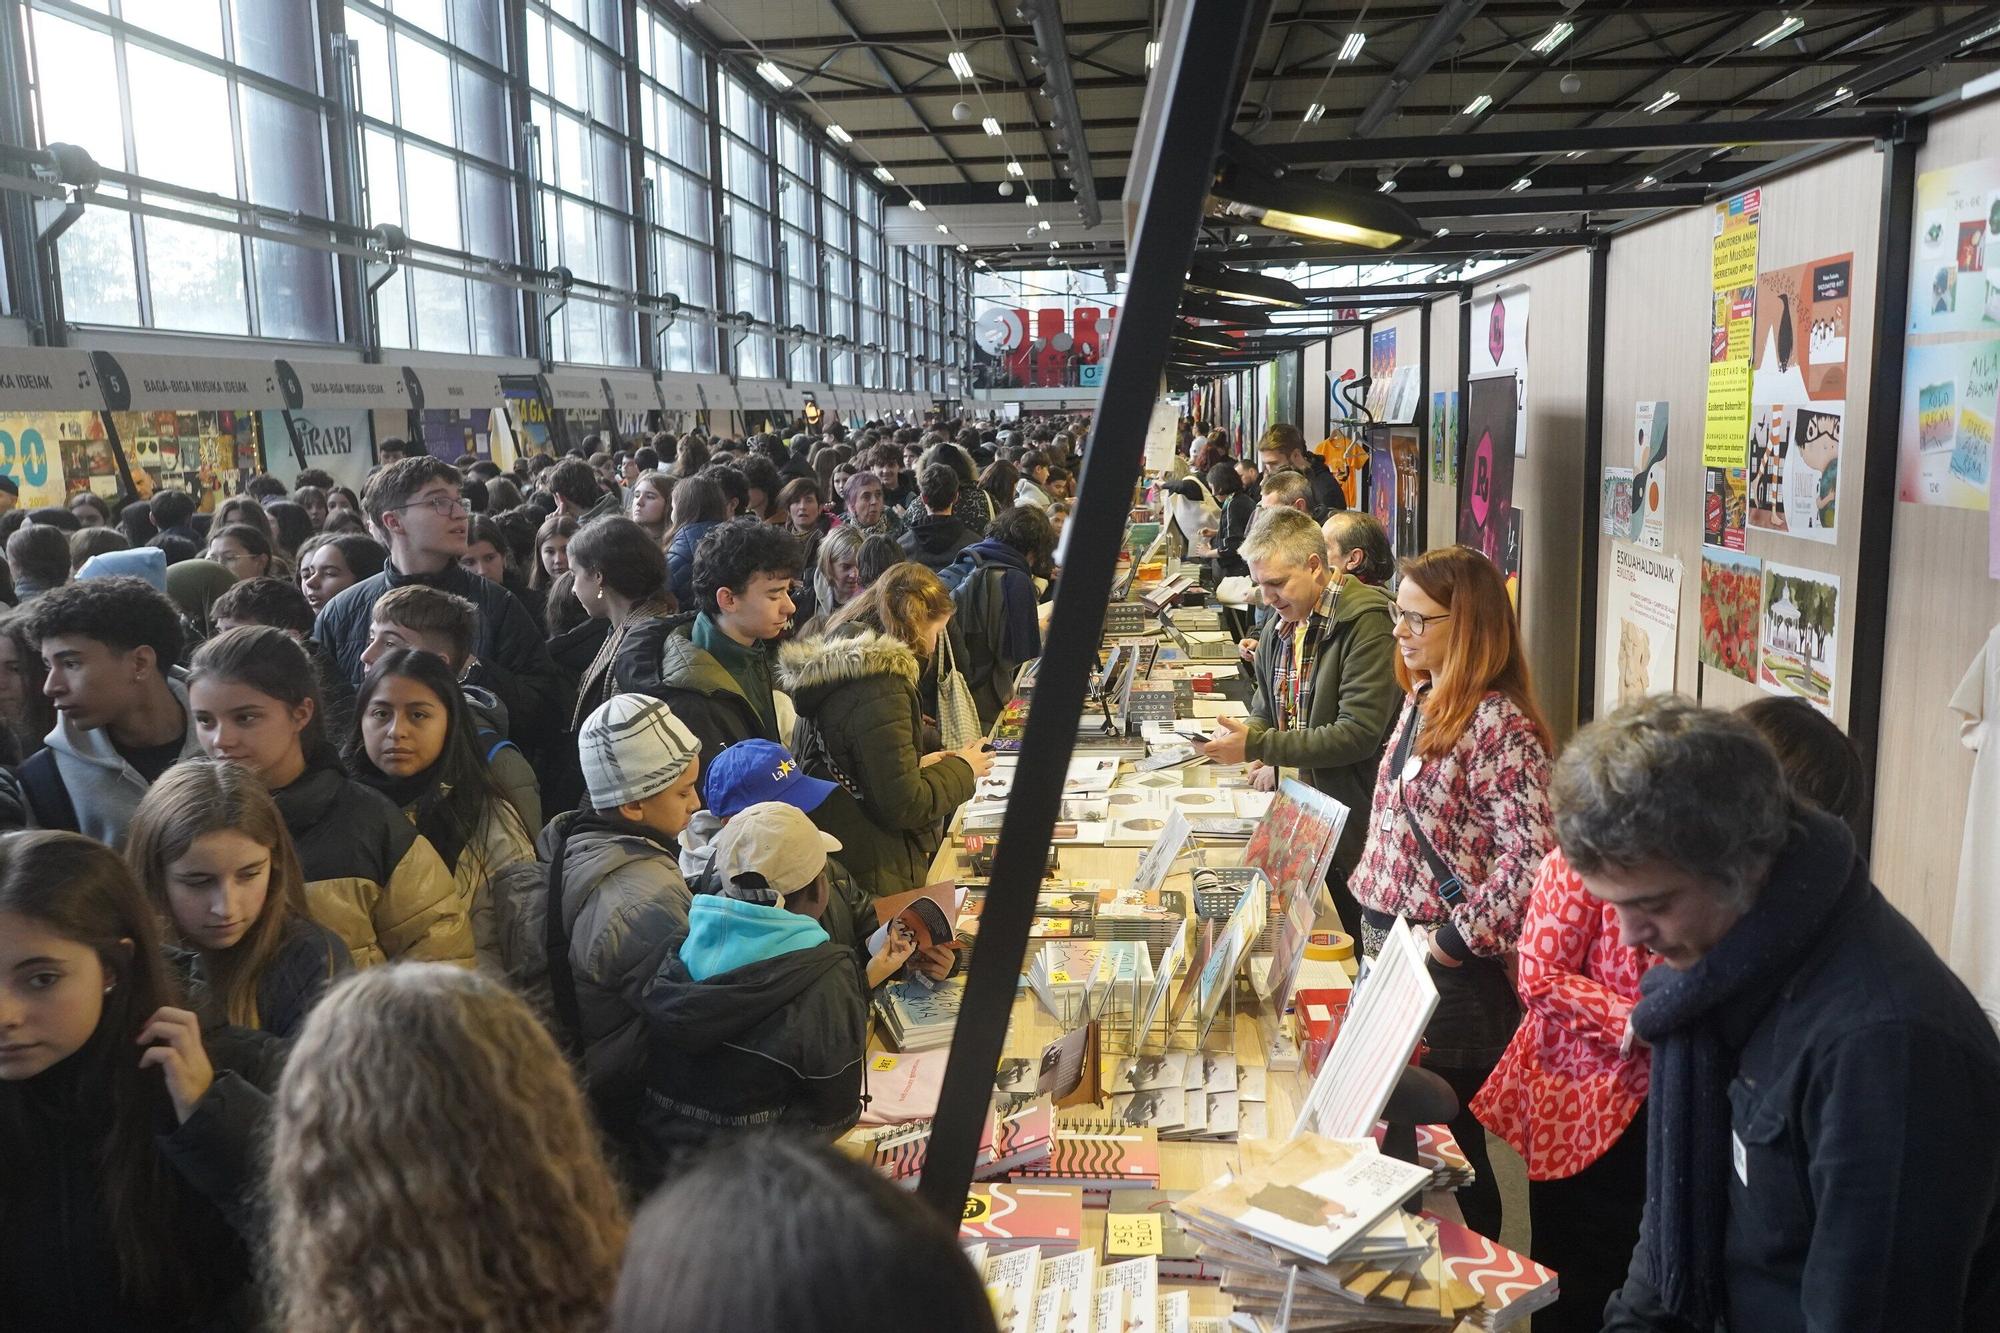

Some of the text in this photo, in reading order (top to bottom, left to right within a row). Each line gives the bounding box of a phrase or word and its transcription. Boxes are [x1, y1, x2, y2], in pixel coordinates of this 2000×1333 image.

[16, 374, 53, 390] IDEIAK
[109, 375, 120, 393] 5
[143, 379, 249, 394] BAGA-BIGA MUSIKA IDEIAK
[1616, 549, 1675, 584] ESKUAHALDUNAK
[771, 769, 784, 782] La
[1113, 1223, 1133, 1247] 35€
[1136, 1219, 1153, 1249] LOTEA
